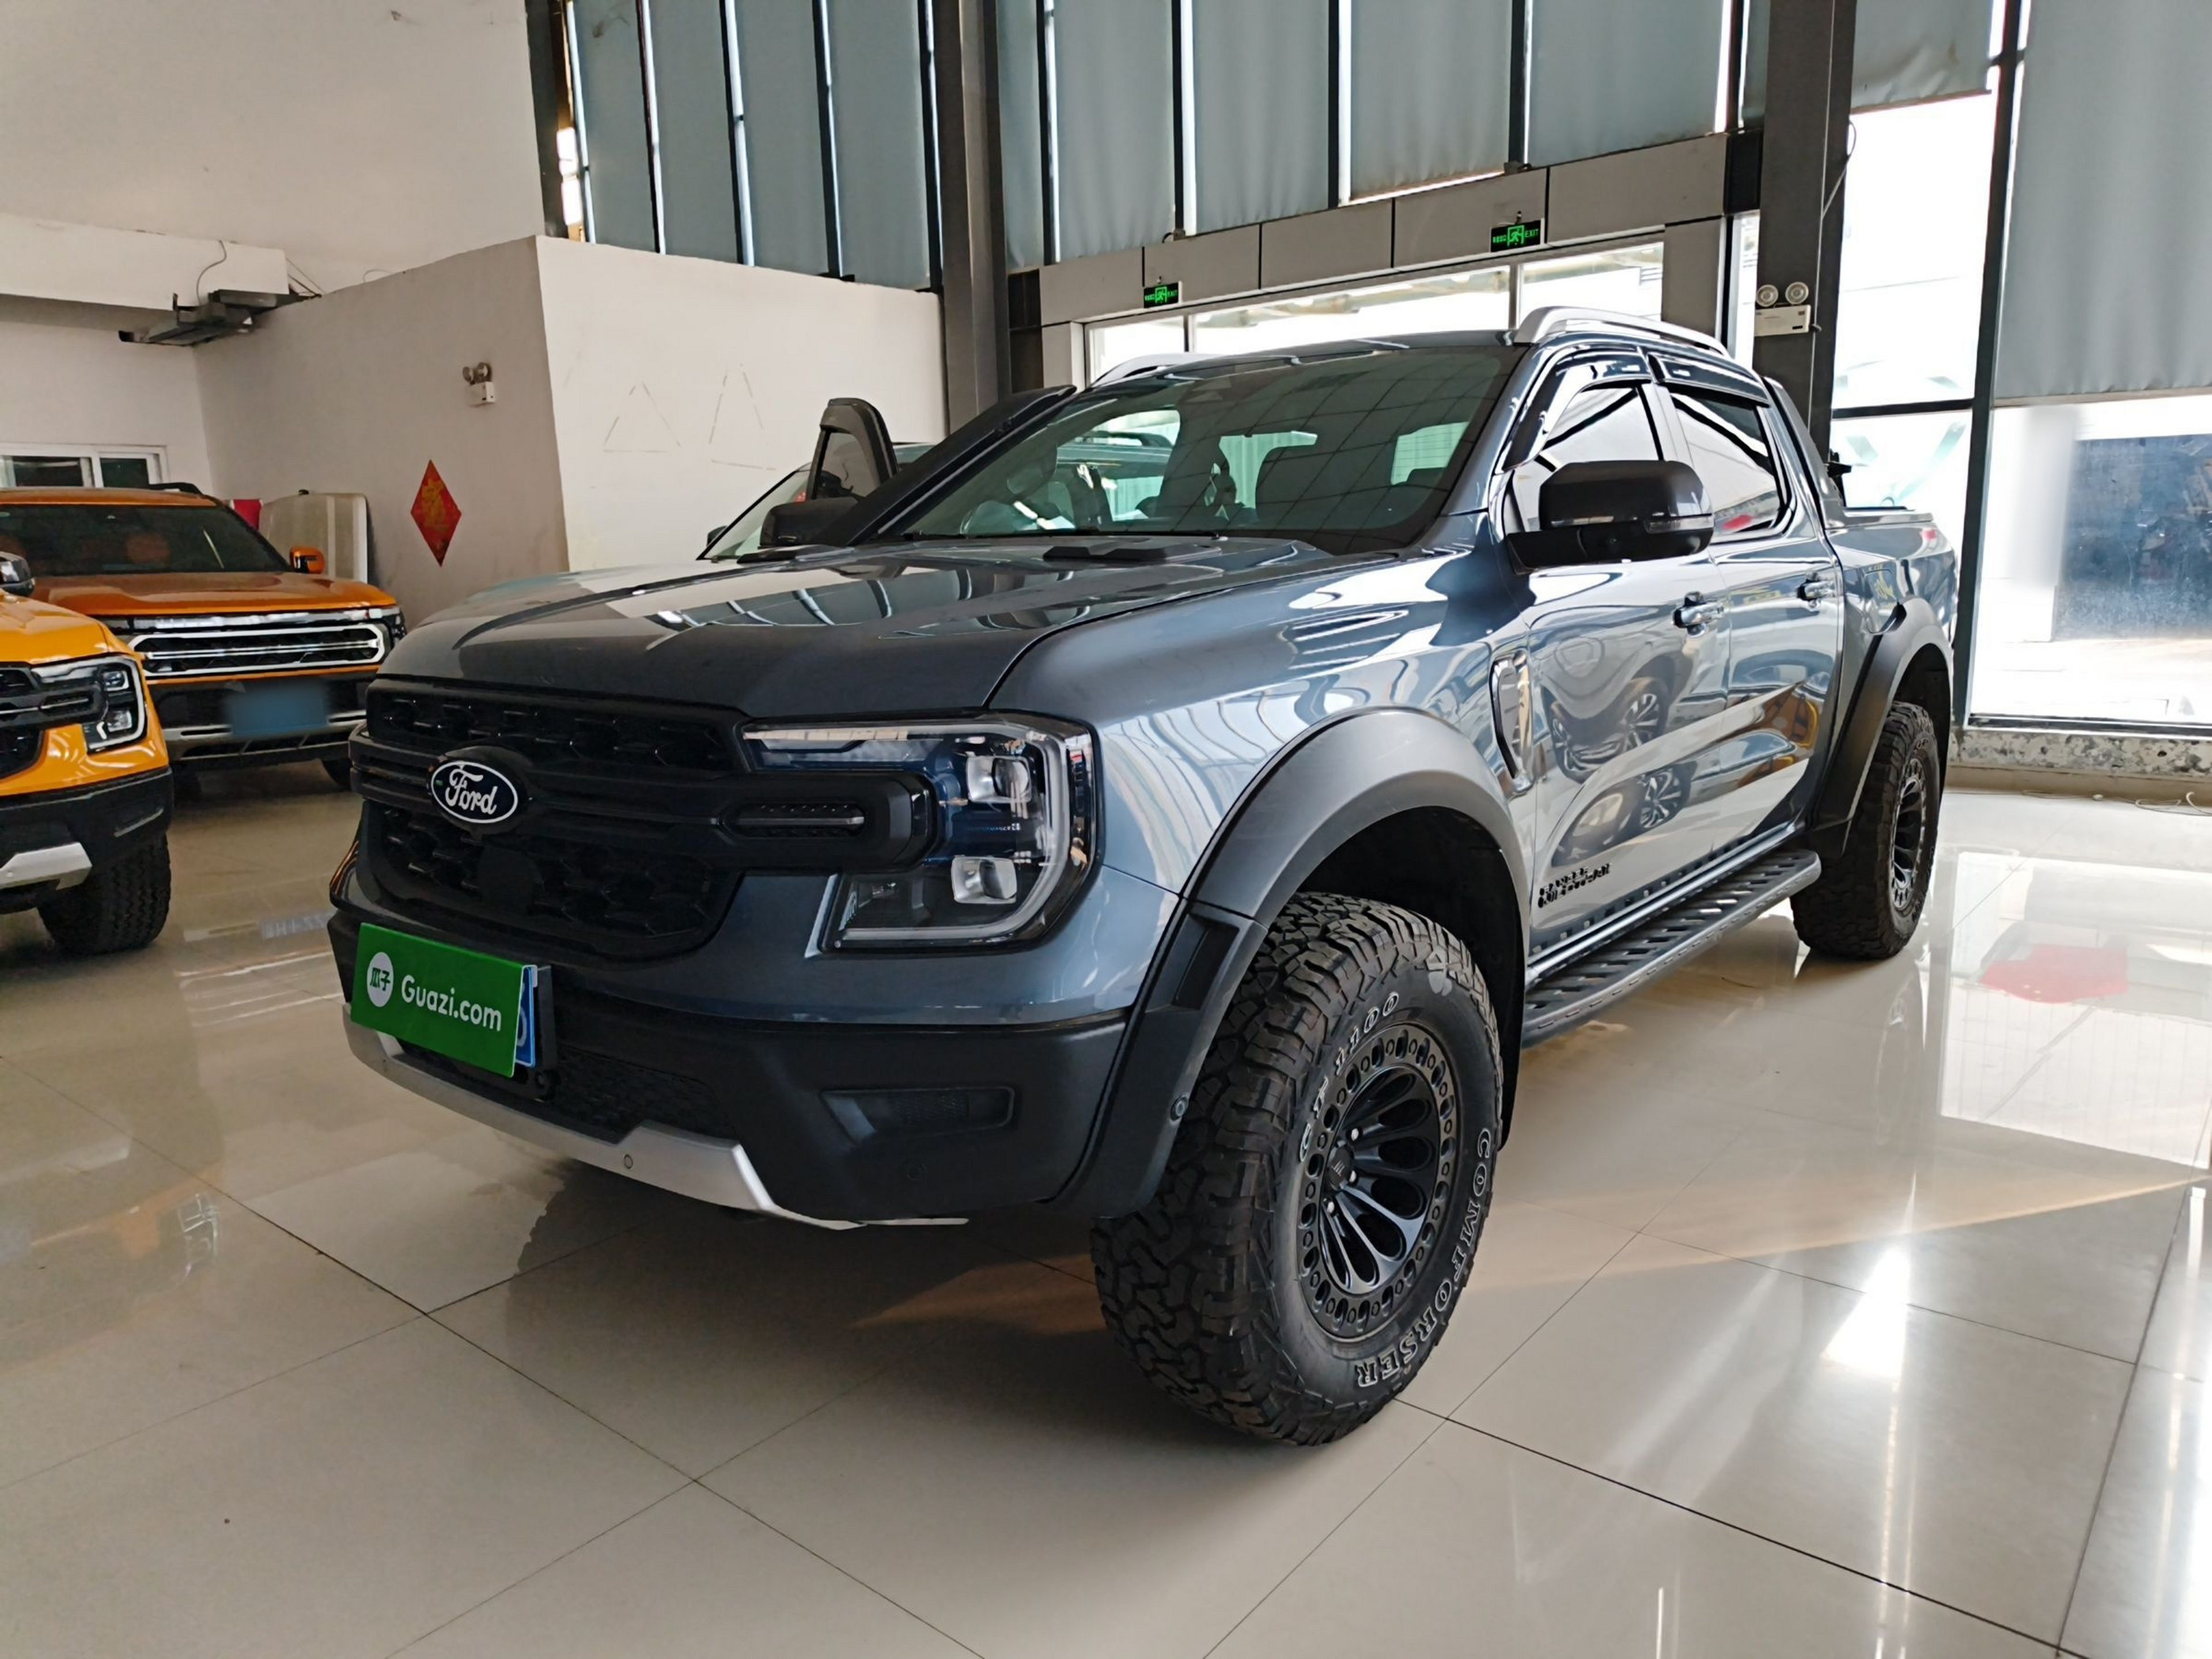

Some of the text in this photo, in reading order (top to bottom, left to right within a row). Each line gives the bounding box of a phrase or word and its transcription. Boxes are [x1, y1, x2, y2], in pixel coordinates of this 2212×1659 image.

[1525, 229, 1539, 237] EXIT
[445, 768, 498, 815] Ford
[369, 967, 391, 991] 瓜子
[401, 974, 502, 1032] Guazi.com
[1355, 1128, 1491, 1388] COMFORSER
